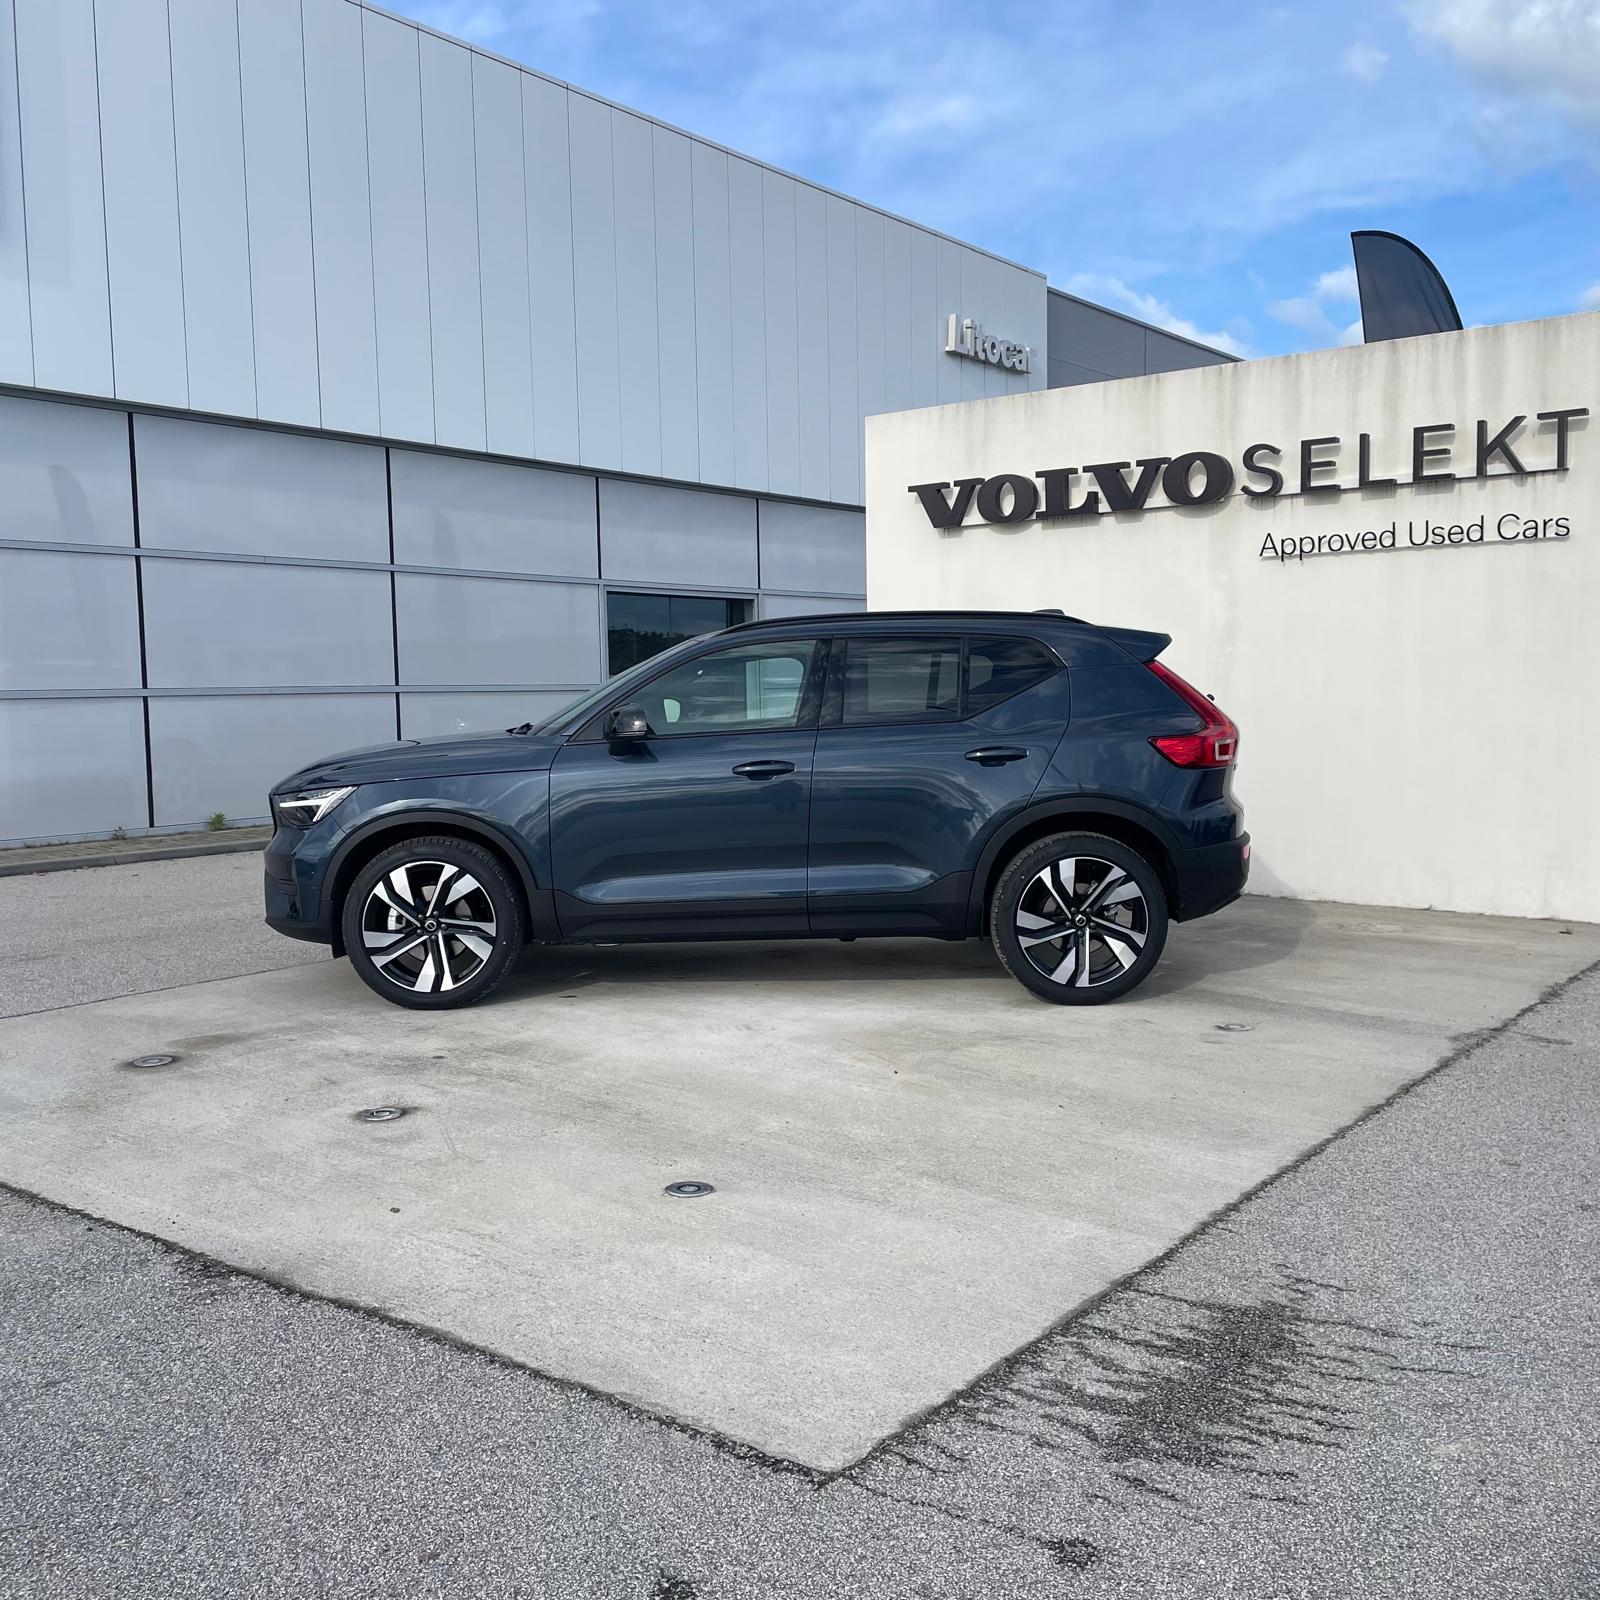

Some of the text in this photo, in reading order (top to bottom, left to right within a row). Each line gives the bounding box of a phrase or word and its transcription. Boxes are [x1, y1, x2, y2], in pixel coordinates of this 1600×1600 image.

[908, 408, 1590, 529] VOLVO SELEKT
[1259, 513, 1571, 562] Approved Used Cars
